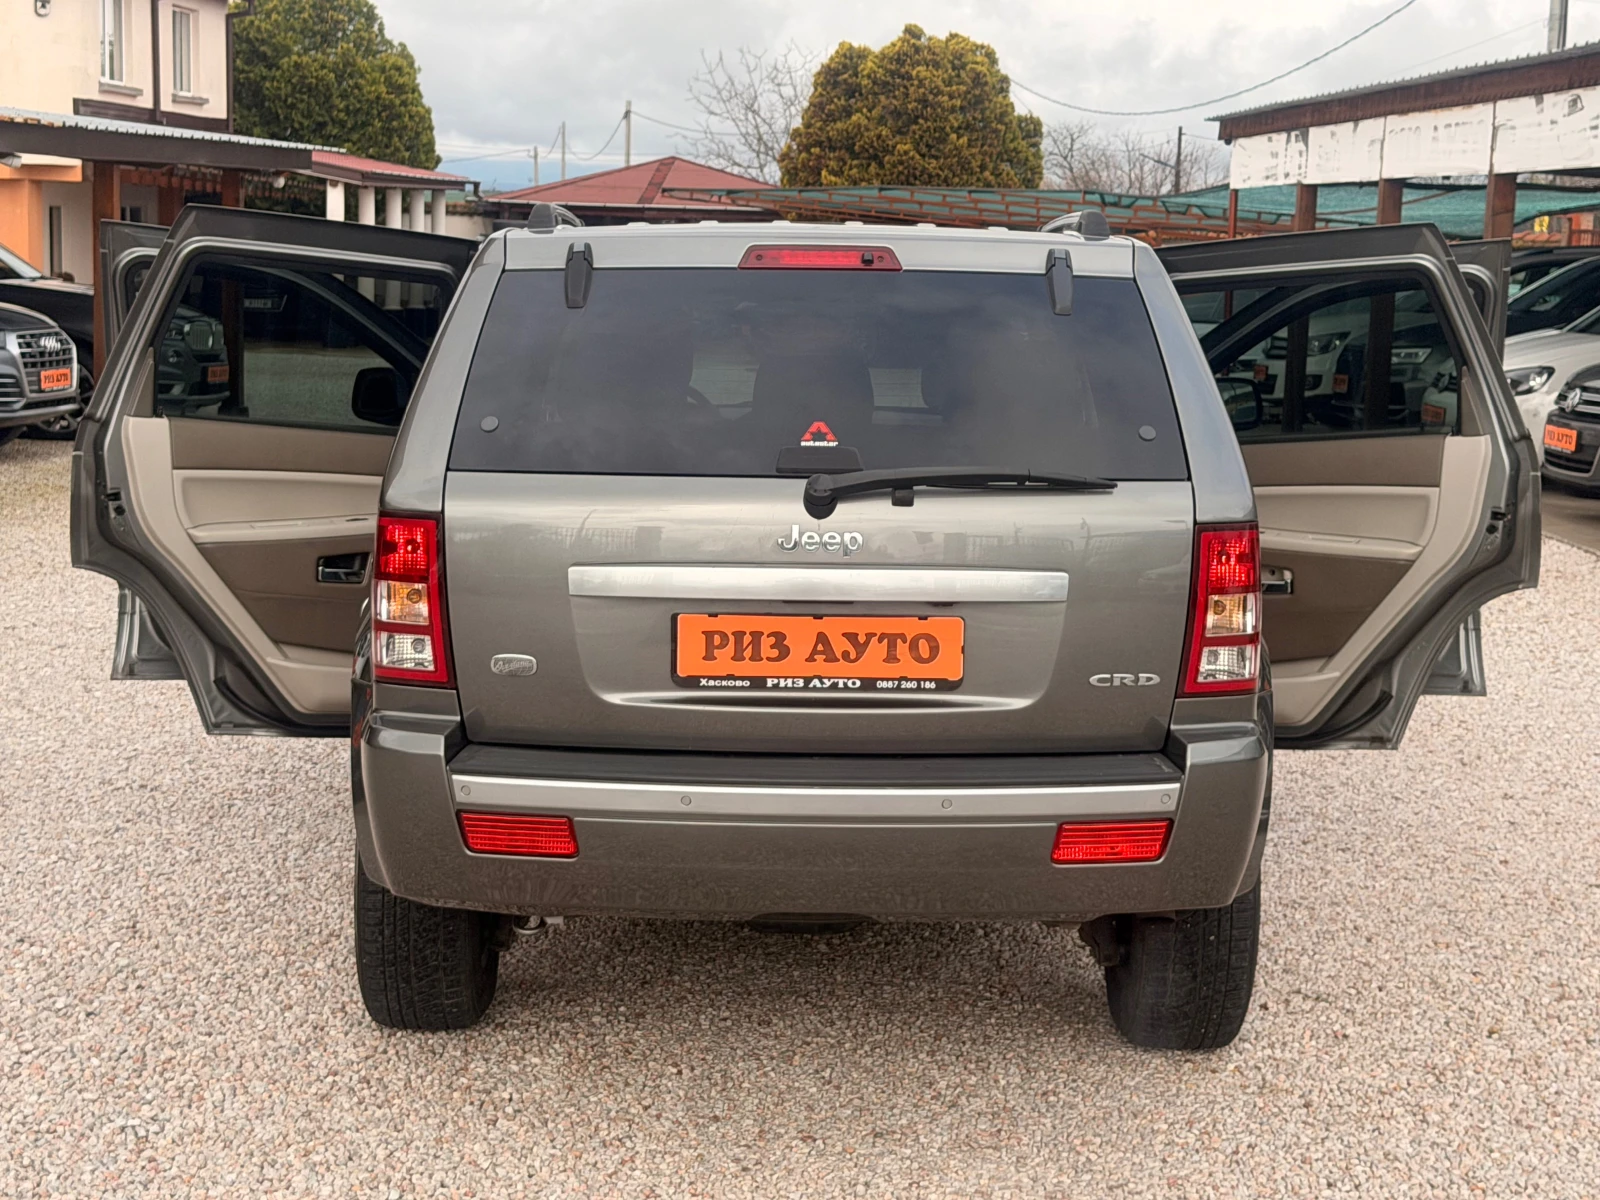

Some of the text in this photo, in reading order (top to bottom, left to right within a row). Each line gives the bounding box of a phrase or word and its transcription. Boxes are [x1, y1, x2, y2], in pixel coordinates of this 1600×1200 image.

[777, 524, 864, 558] Jeep
[701, 630, 941, 665] РИЗ АУТО
[699, 677, 936, 689] Хасково РИЗ АУТО 0887 260 186
[1089, 673, 1161, 687] CRD
